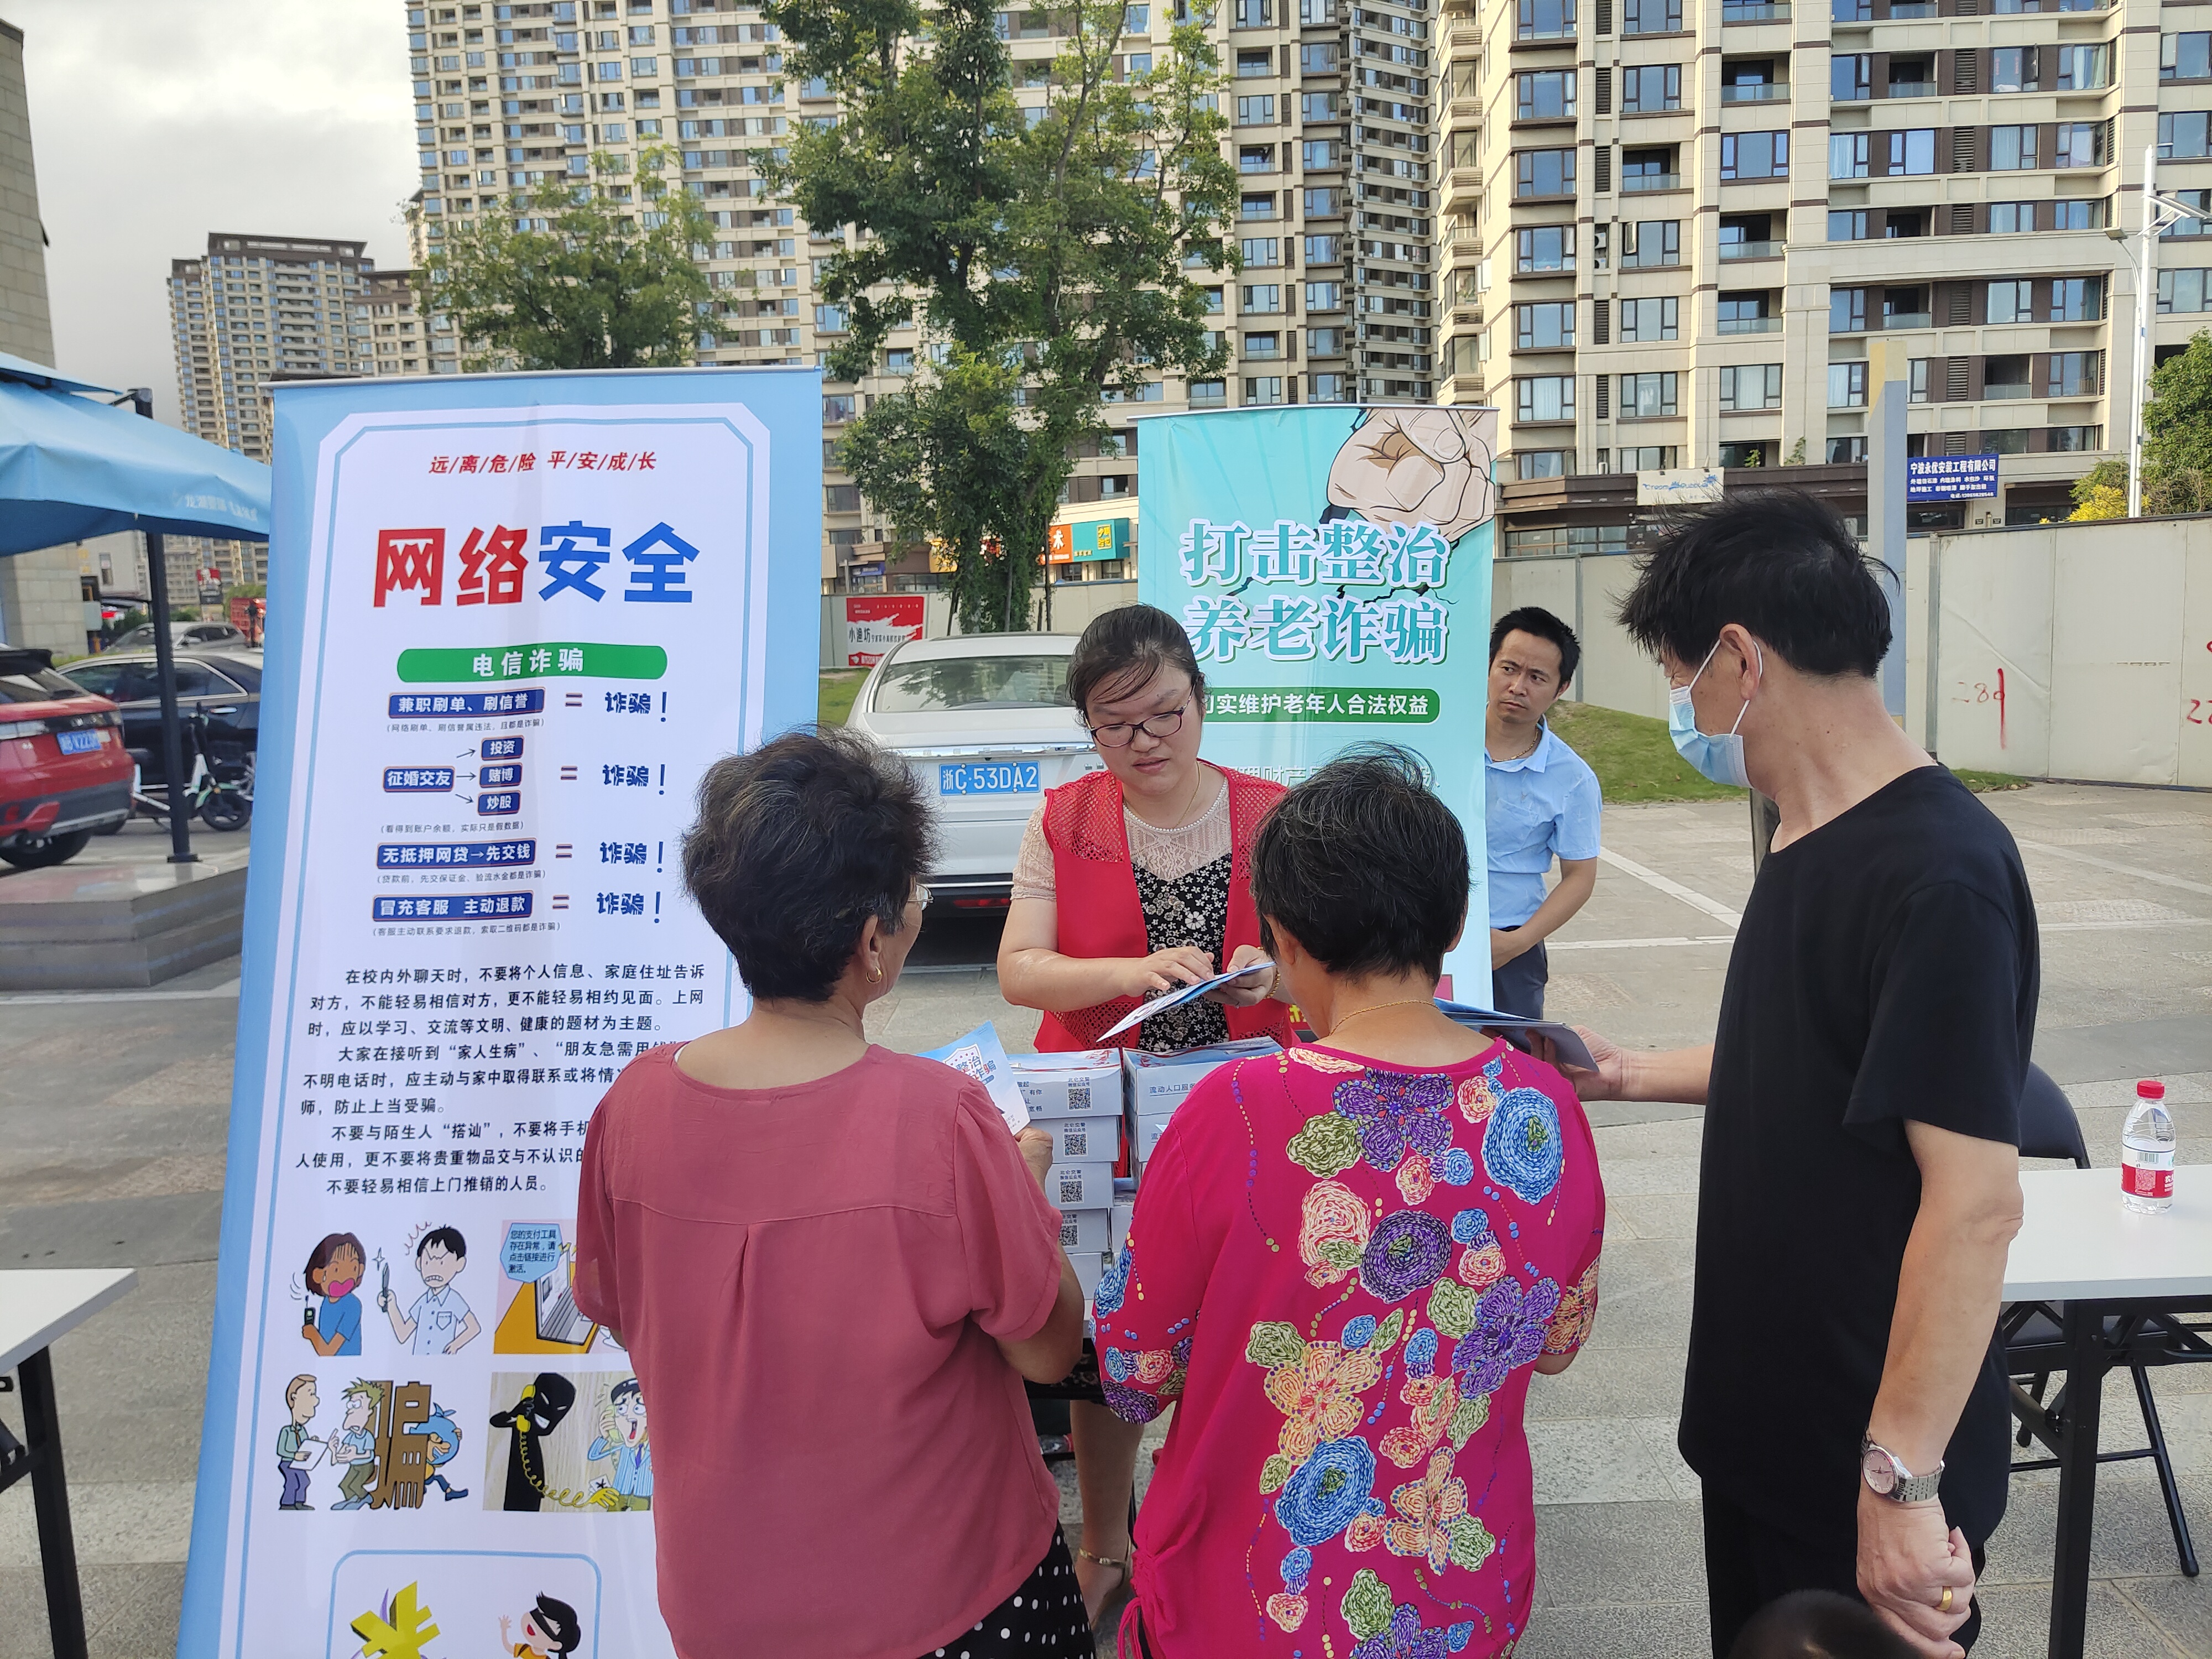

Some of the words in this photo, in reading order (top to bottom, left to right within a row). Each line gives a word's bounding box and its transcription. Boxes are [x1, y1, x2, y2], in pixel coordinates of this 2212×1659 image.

[1180, 519, 1452, 587] 打击整治
[373, 520, 701, 608] 网络安全
[1183, 596, 1448, 664] 养老诈骗
[473, 648, 584, 677] 电信诈骗
[398, 693, 528, 713] 兼职刷单、刷信誉
[490, 740, 515, 755] 投资
[388, 770, 451, 786] 征婚交友
[488, 767, 514, 782] 赌博
[943, 766, 1037, 791] 浙C·53DA2
[487, 795, 512, 810] 炒股
[380, 899, 449, 916] 冒充客服
[463, 896, 525, 915] 主动退款
[346, 963, 705, 984] 在校内外聊天时，不要将个人信息、家庭住址告诉
[310, 989, 703, 1010] 对方，不能轻易相信对方，更不能轻易相约见面。上网
[308, 1015, 661, 1037] 时，应以学习、交流等文明、健康的题材为主题。
[338, 1041, 665, 1062] 大家在接听到“家人生病”、“朋友急需用
[304, 1067, 622, 1088] 不明电话时，应主动与家中取得联系或将情
[301, 1098, 444, 1116] 师，防止上当受骗。
[327, 1175, 546, 1194] 不要轻易相信上门推销的人员。
